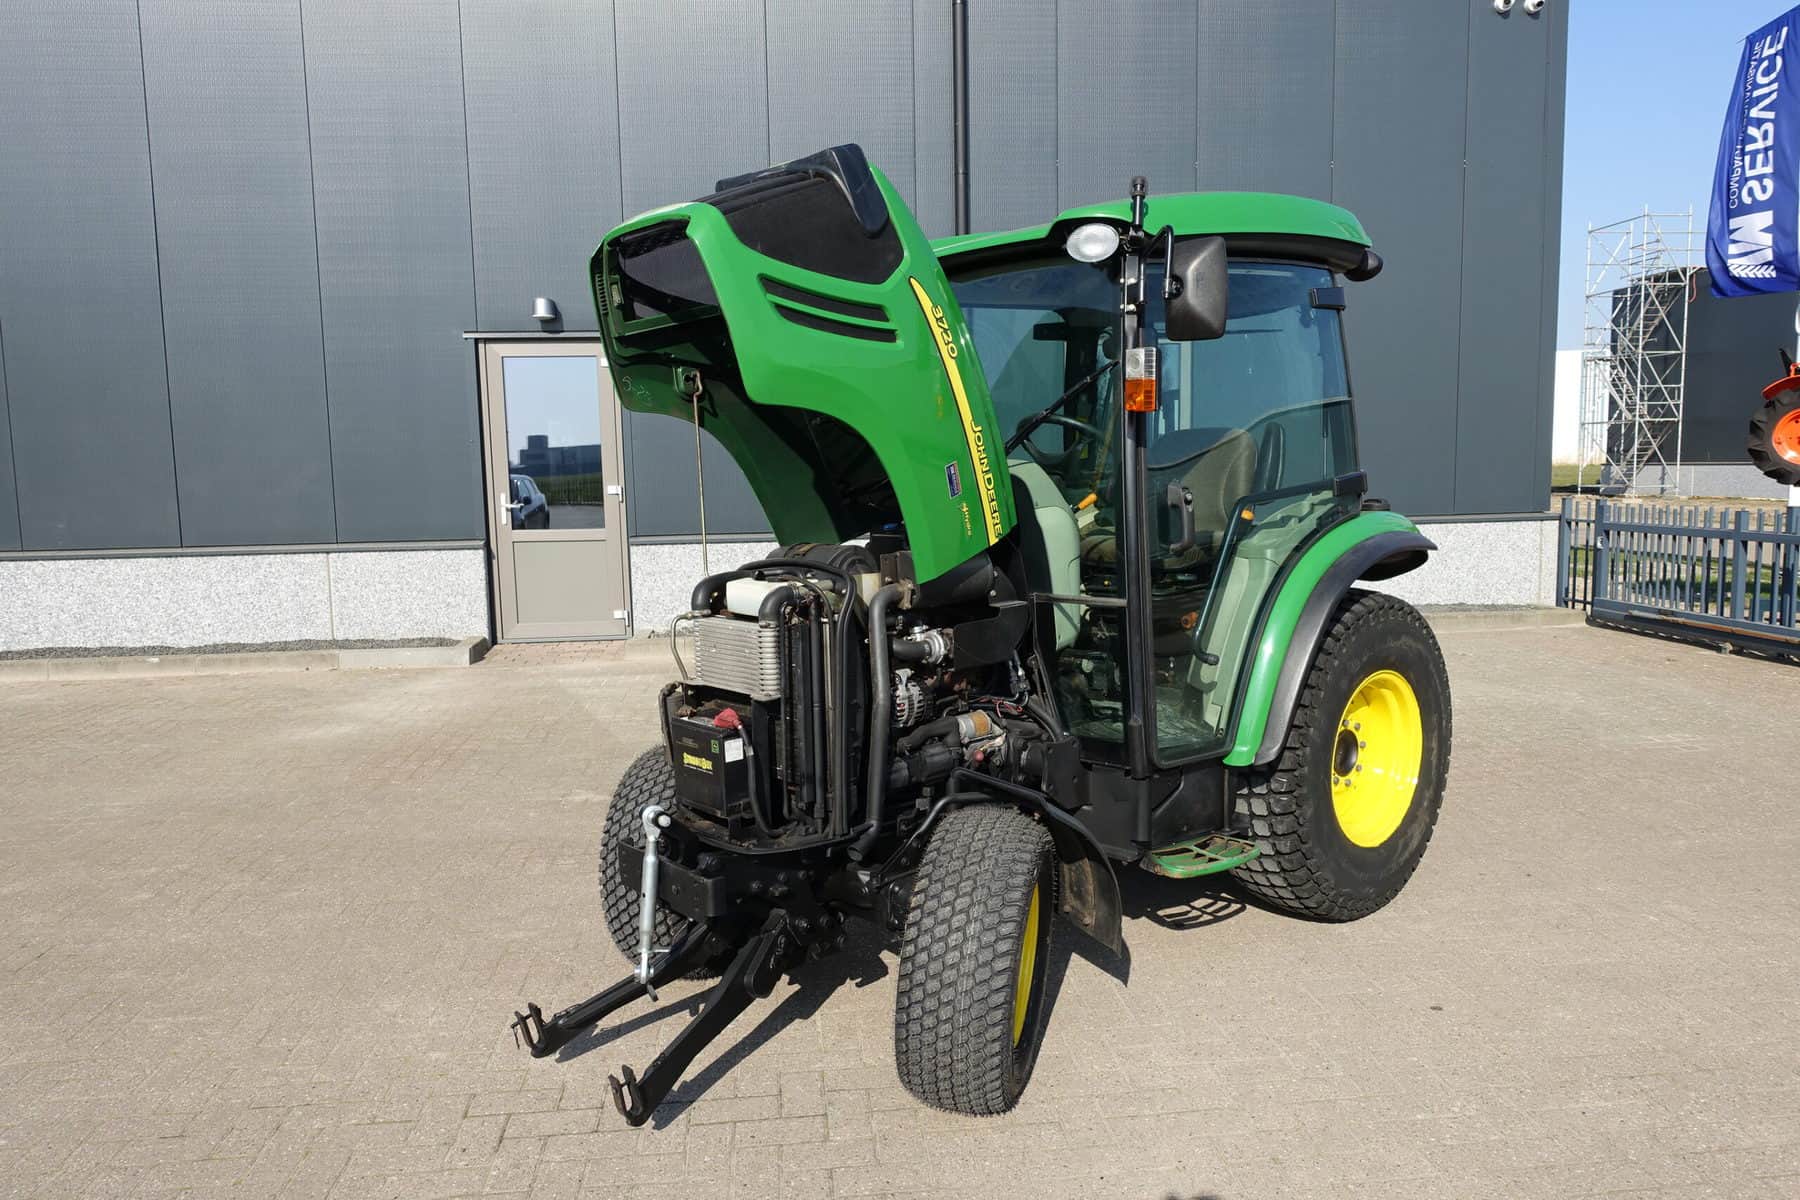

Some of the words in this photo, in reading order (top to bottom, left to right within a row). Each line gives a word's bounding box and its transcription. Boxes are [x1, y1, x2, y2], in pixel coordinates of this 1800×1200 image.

[932, 304, 958, 359] 3720
[971, 420, 991, 476] JOHN
[984, 473, 1003, 537] DEERE
